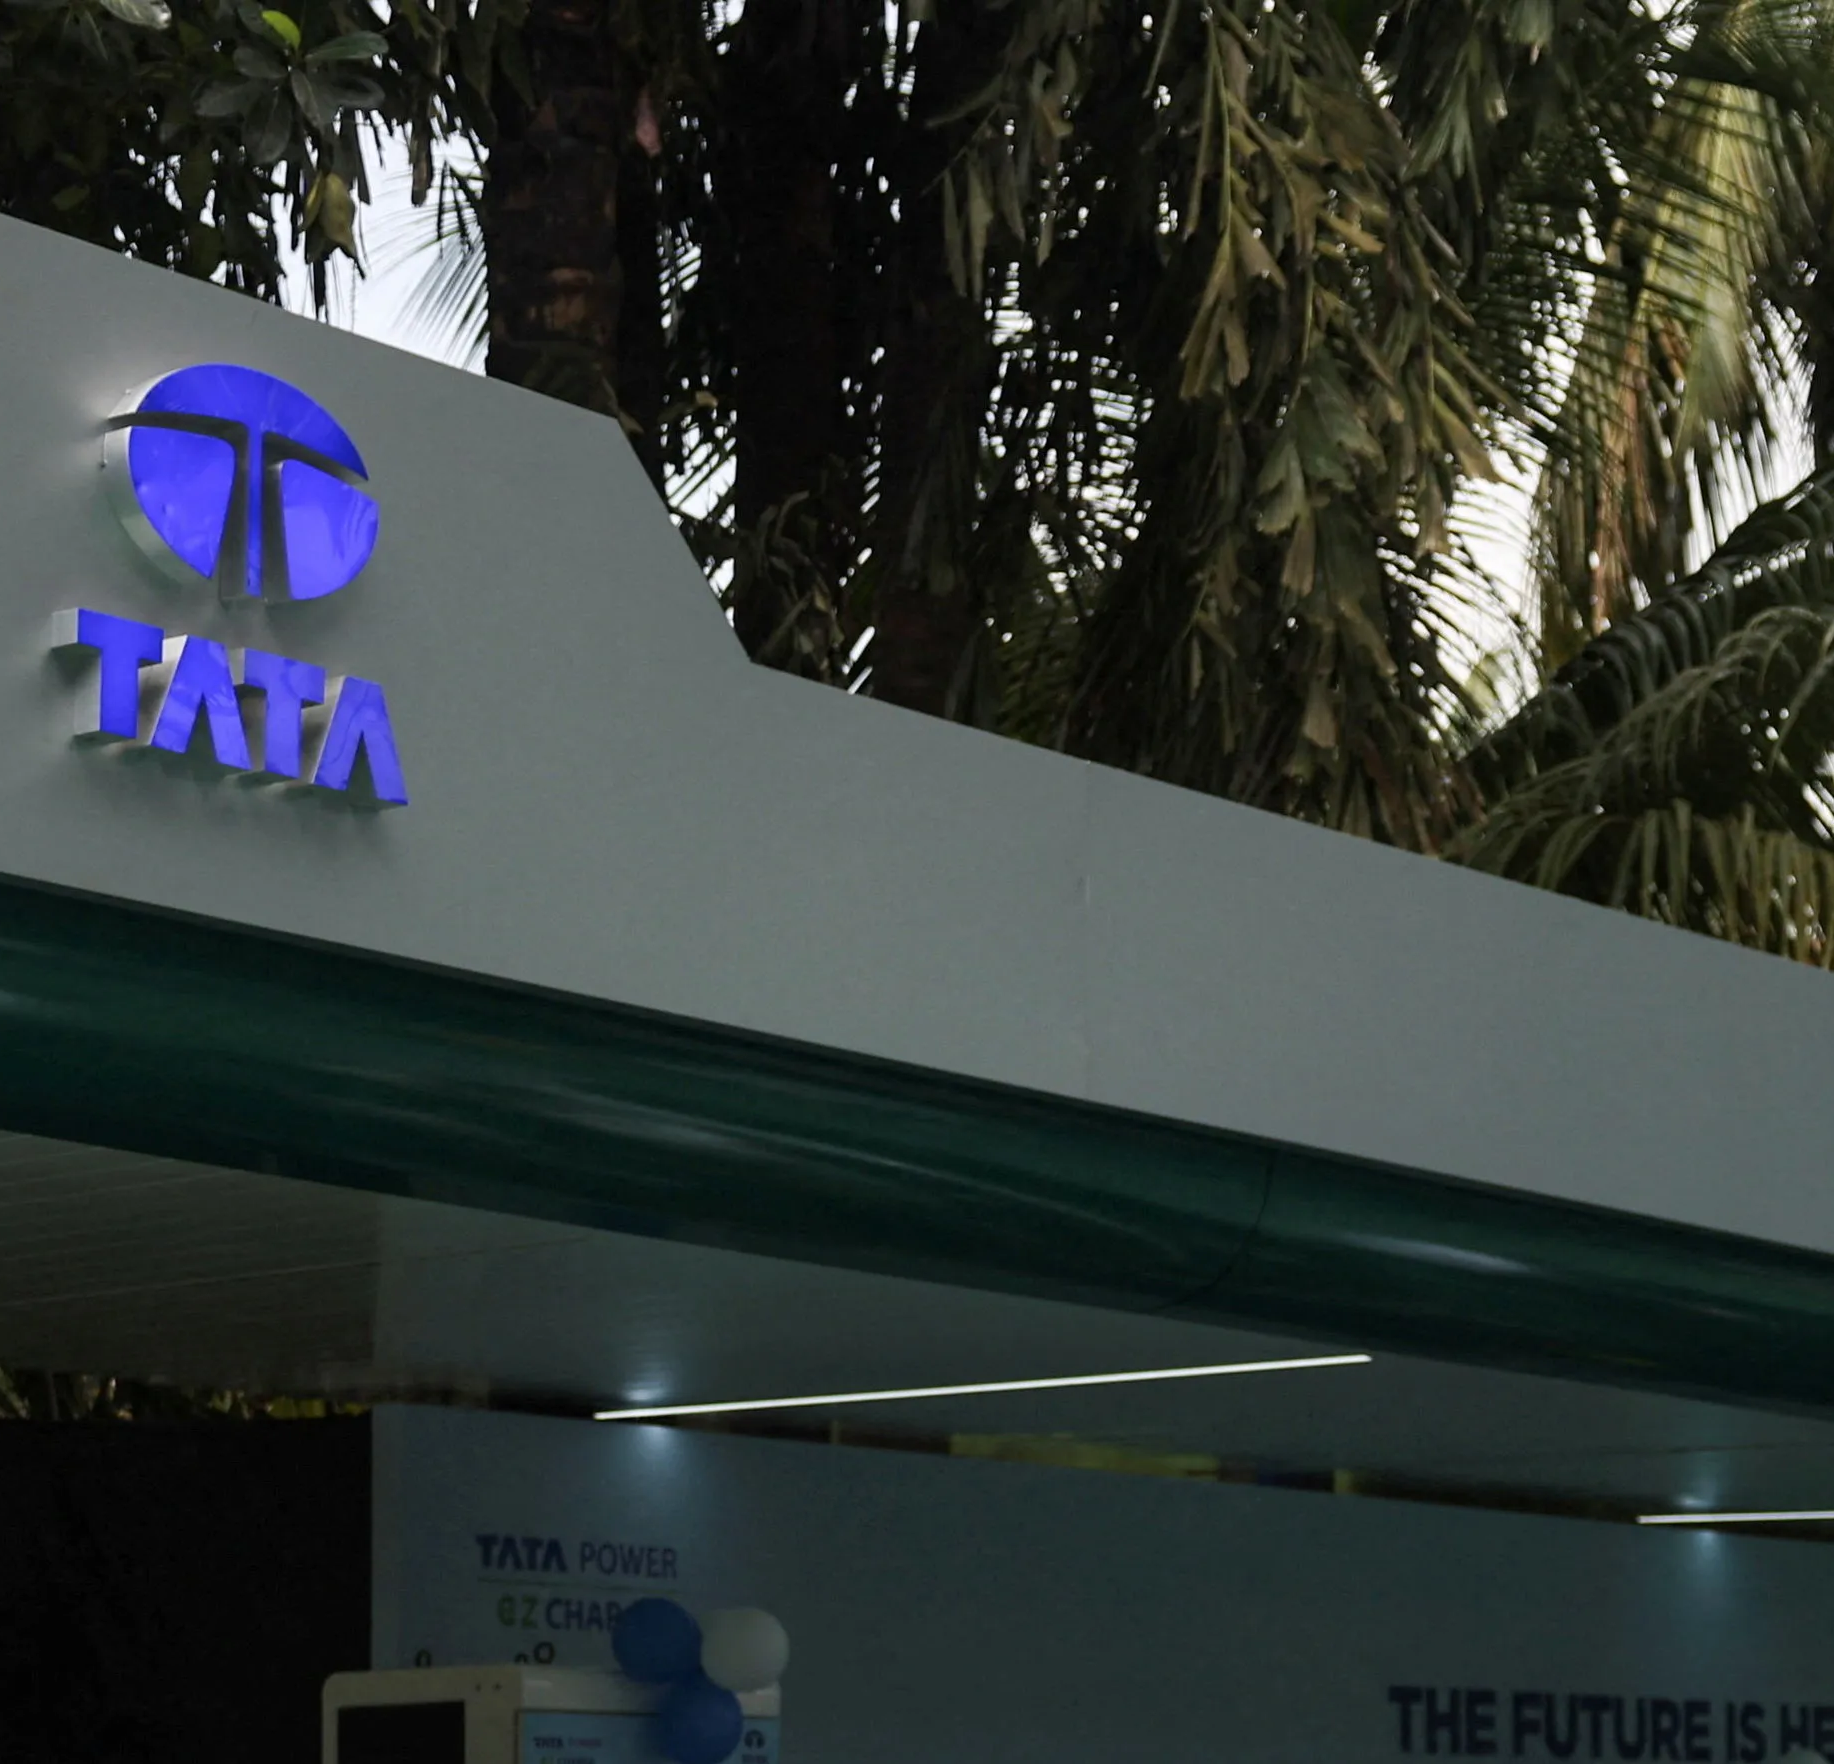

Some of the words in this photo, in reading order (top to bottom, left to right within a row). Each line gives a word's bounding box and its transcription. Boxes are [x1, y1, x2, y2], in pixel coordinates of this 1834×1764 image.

[72, 606, 409, 808] TATA
[474, 1533, 568, 1573] TATA
[579, 1541, 679, 1579] POWER
[1387, 1685, 1497, 1757] THE
[1513, 1690, 1713, 1763] FUTURE
[1725, 1700, 1768, 1764] IS
